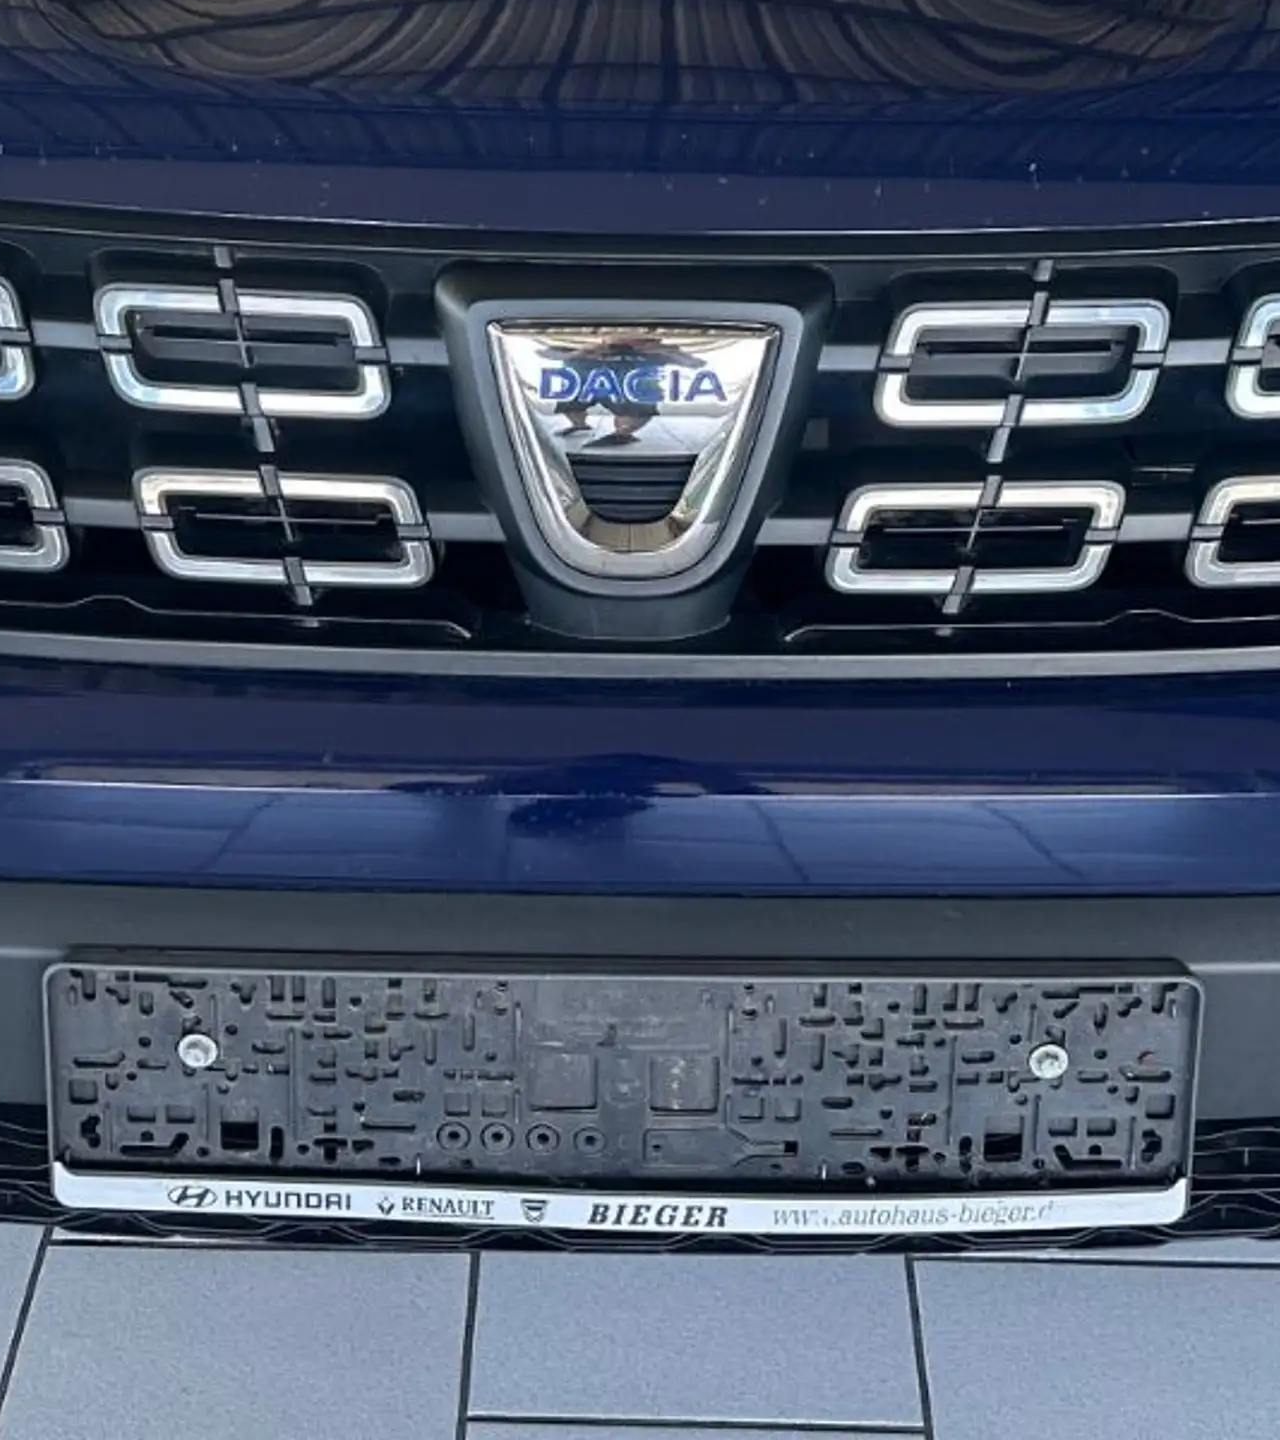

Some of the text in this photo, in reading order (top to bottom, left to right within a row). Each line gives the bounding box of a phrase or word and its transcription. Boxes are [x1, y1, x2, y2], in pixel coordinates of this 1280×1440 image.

[539, 366, 728, 402] DACIA
[224, 1189, 352, 1212] HYUNDAI
[401, 1196, 496, 1216] RENAULT
[587, 1202, 729, 1228] BIEGER
